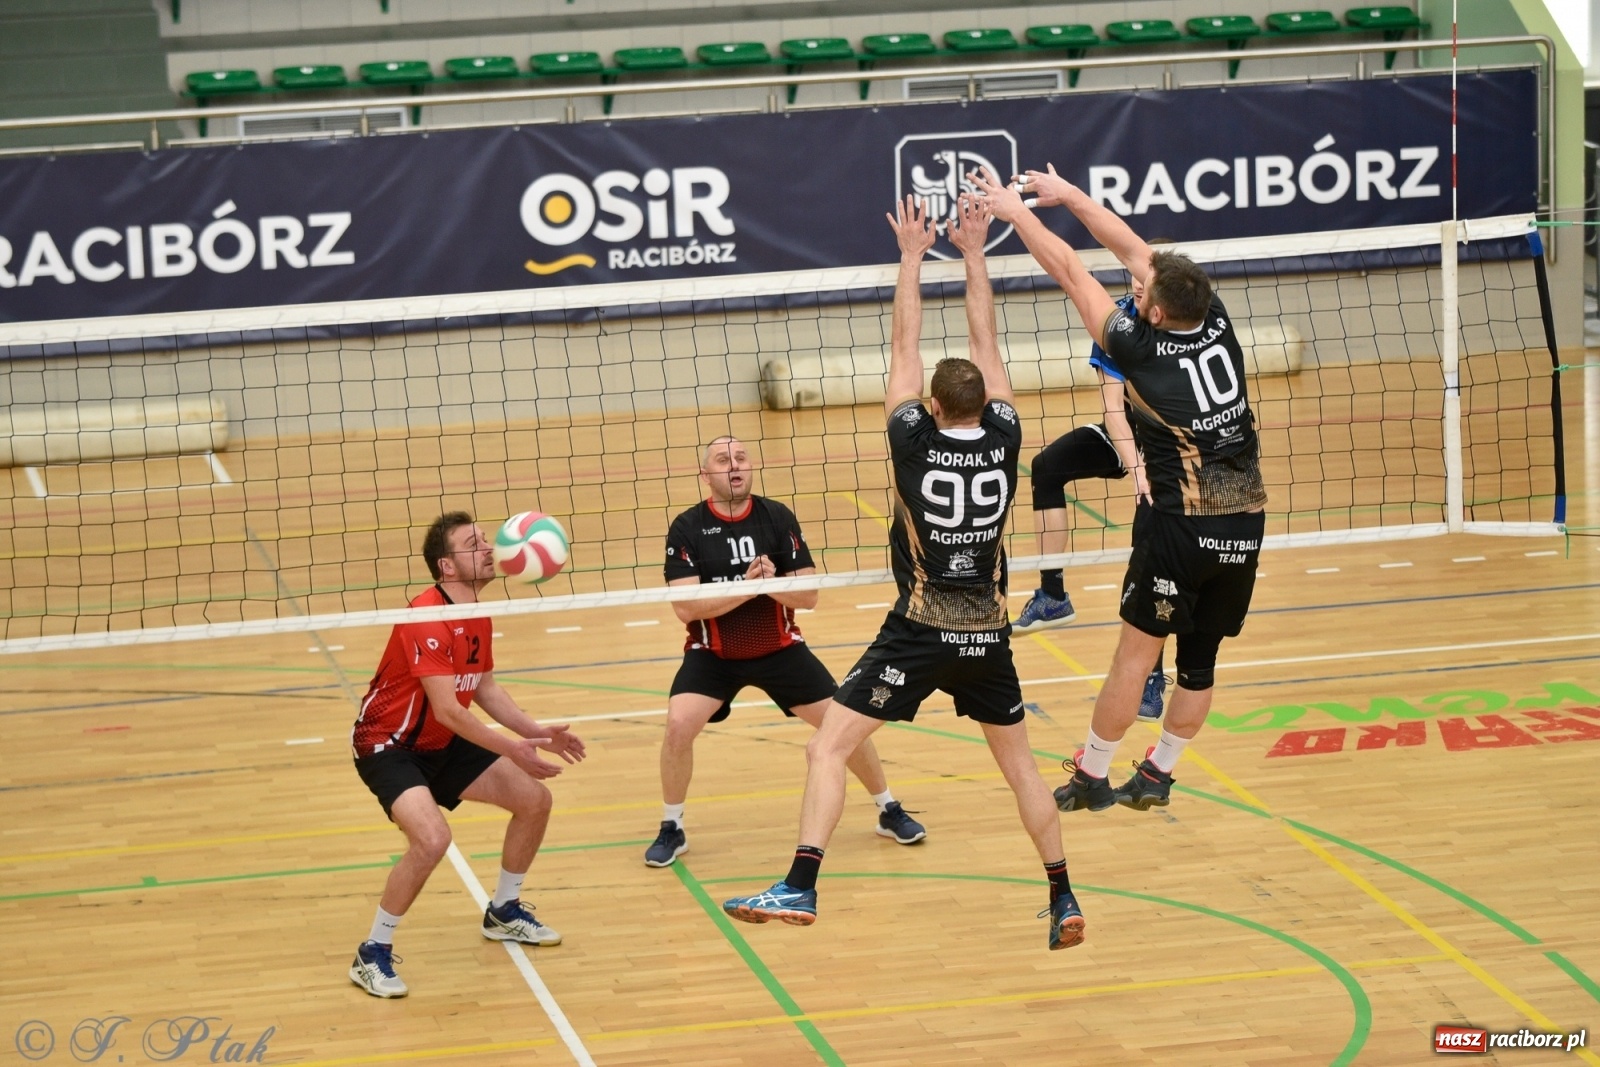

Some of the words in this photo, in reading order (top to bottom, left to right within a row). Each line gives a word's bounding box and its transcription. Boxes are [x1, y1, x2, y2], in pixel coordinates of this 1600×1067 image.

[1089, 134, 1440, 216] RACIBÓRZ
[608, 238, 737, 270] RACIBÓRZ
[1178, 344, 1239, 413] 10
[1192, 396, 1247, 432] AGROTIM
[990, 447, 1005, 464] W
[921, 469, 1008, 528] 99
[929, 526, 998, 545] AGROTIM
[1198, 536, 1258, 550] VOLLEYBALL
[727, 536, 756, 565] 10
[1218, 553, 1247, 564] TEAM
[466, 635, 480, 664] 12
[940, 631, 1000, 644] VOLLEYBALL
[958, 646, 986, 657] TEAM
